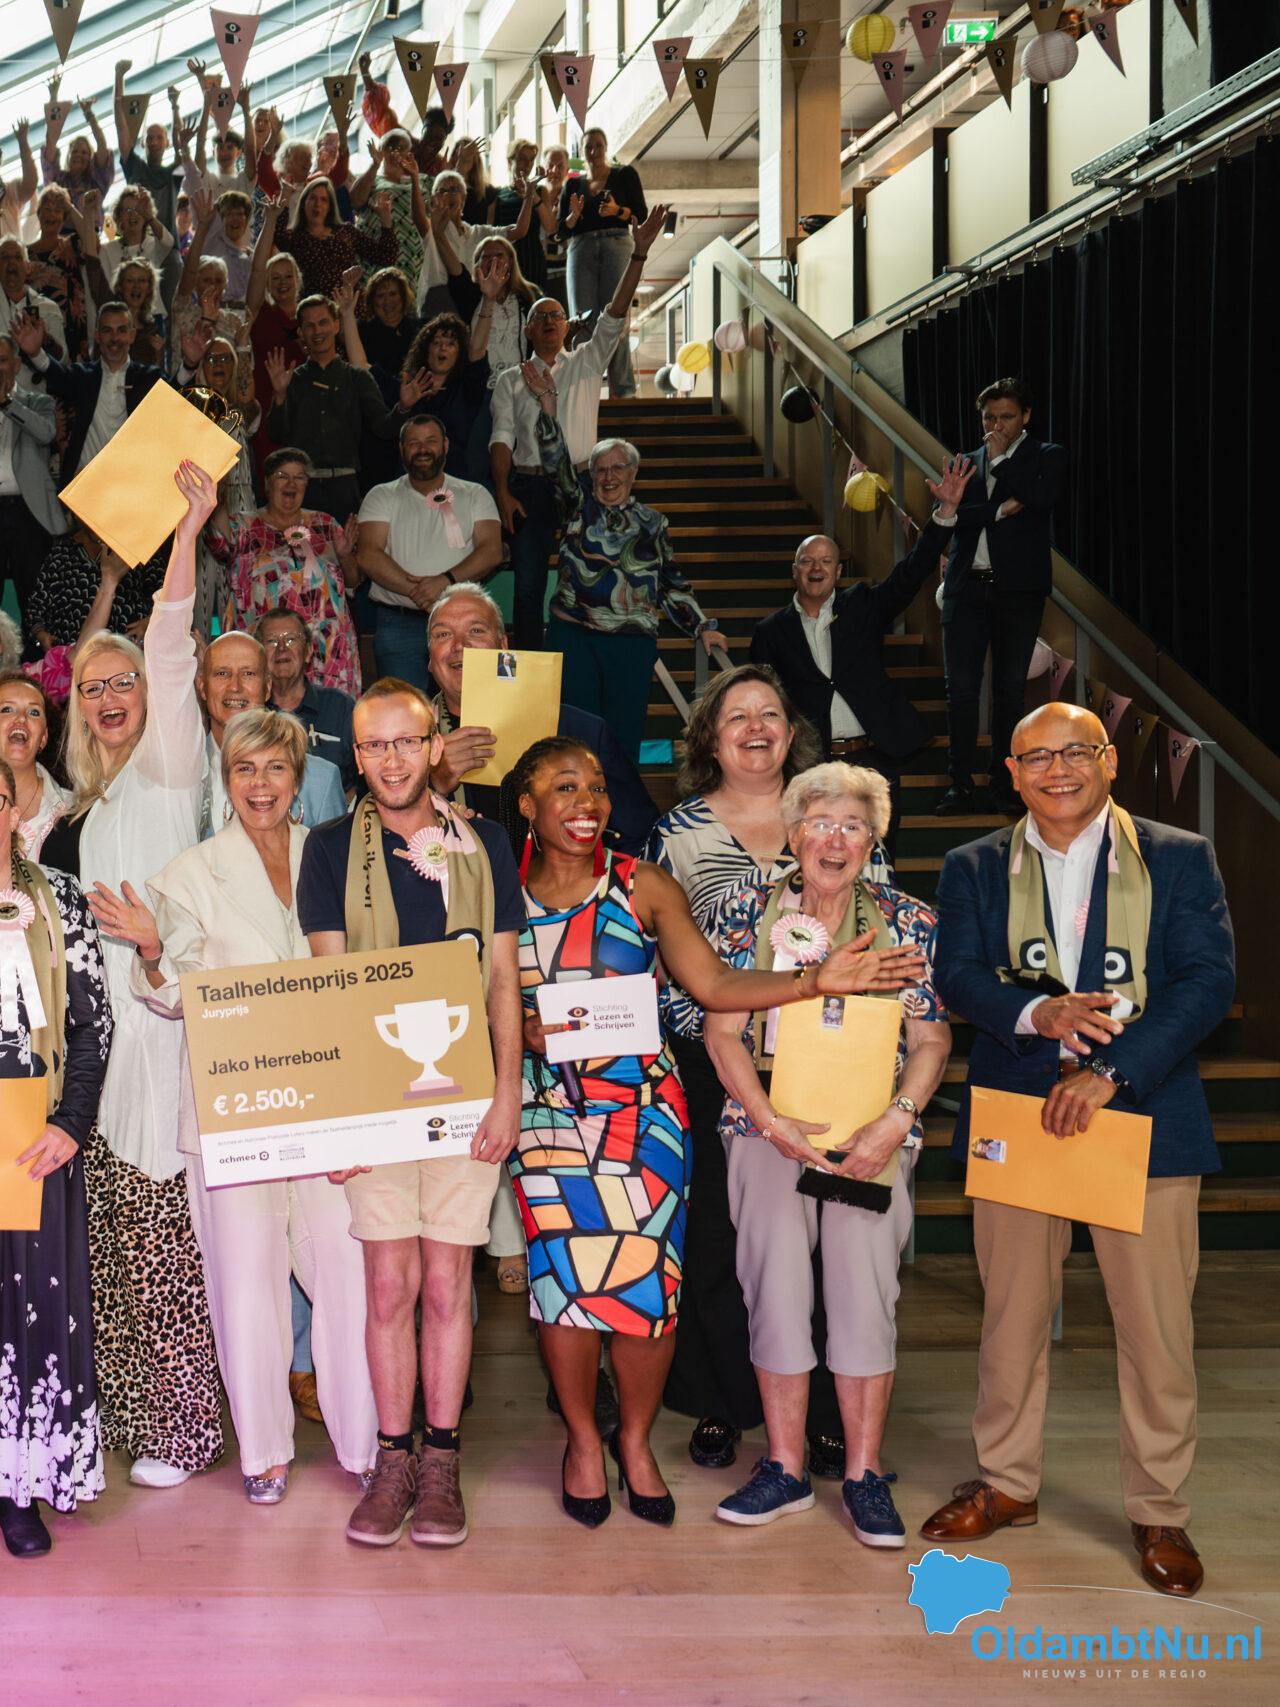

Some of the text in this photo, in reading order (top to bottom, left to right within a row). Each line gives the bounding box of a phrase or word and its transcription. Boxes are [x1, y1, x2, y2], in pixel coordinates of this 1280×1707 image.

[197, 960, 414, 1003] Taalheldenprijs 2025
[201, 1004, 250, 1020] Juryprijs
[592, 1003, 629, 1013] Stichting
[593, 1012, 634, 1021] Lezen en
[594, 1021, 635, 1030] Schrijven
[208, 1046, 341, 1076] Jako Herrebout
[212, 1086, 315, 1116] € 2.500,-
[450, 1122, 474, 1131] Lezen
[451, 1130, 476, 1140] Schrij
